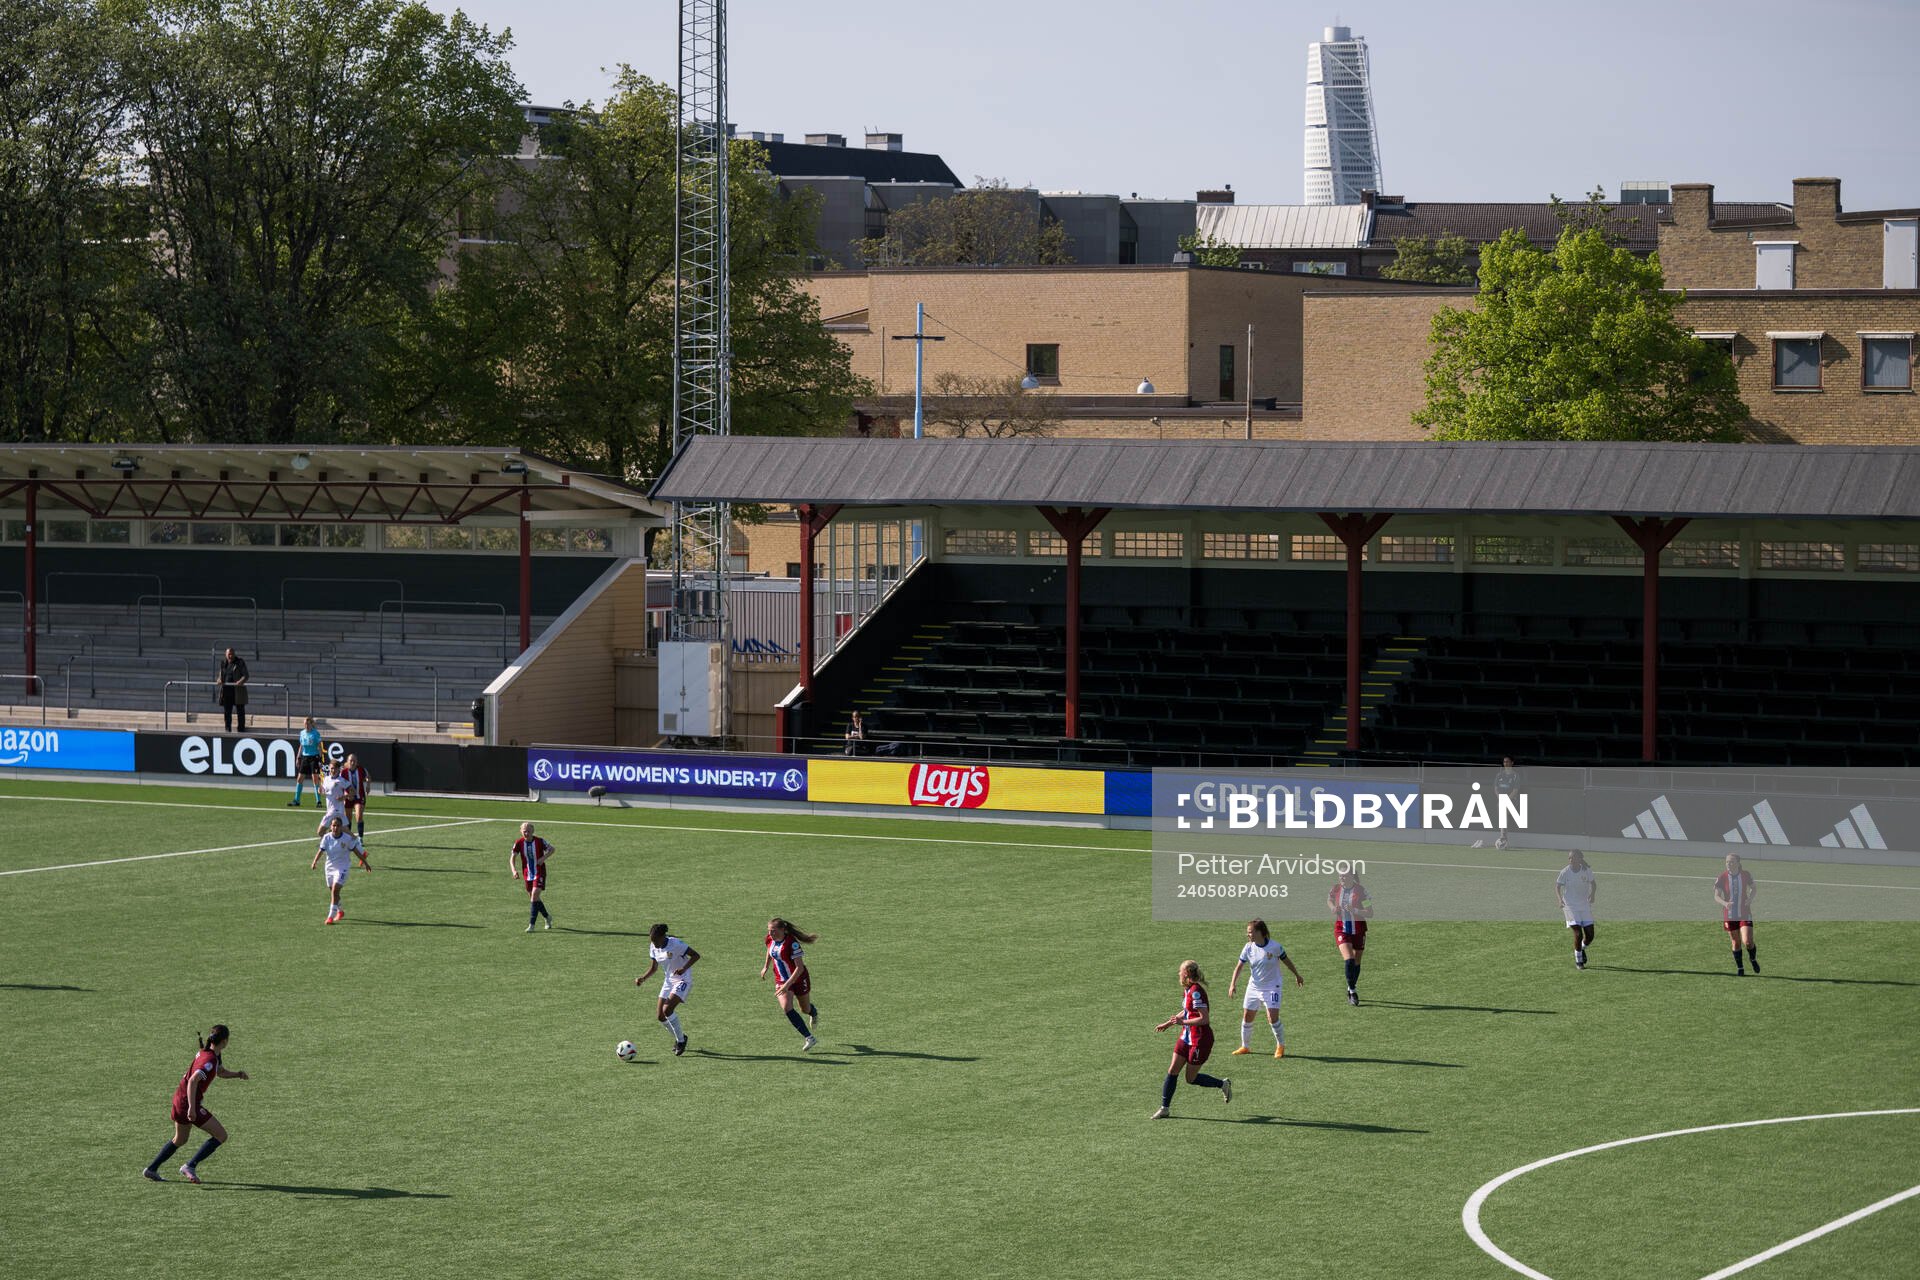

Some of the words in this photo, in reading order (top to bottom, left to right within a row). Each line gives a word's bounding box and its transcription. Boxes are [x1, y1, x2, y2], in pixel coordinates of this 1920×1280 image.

[0, 729, 59, 753] azon
[558, 763, 603, 781] UEFA
[605, 765, 689, 785] WOMEN'S
[694, 769, 776, 788] UNDER-17
[913, 764, 985, 808] Lay's
